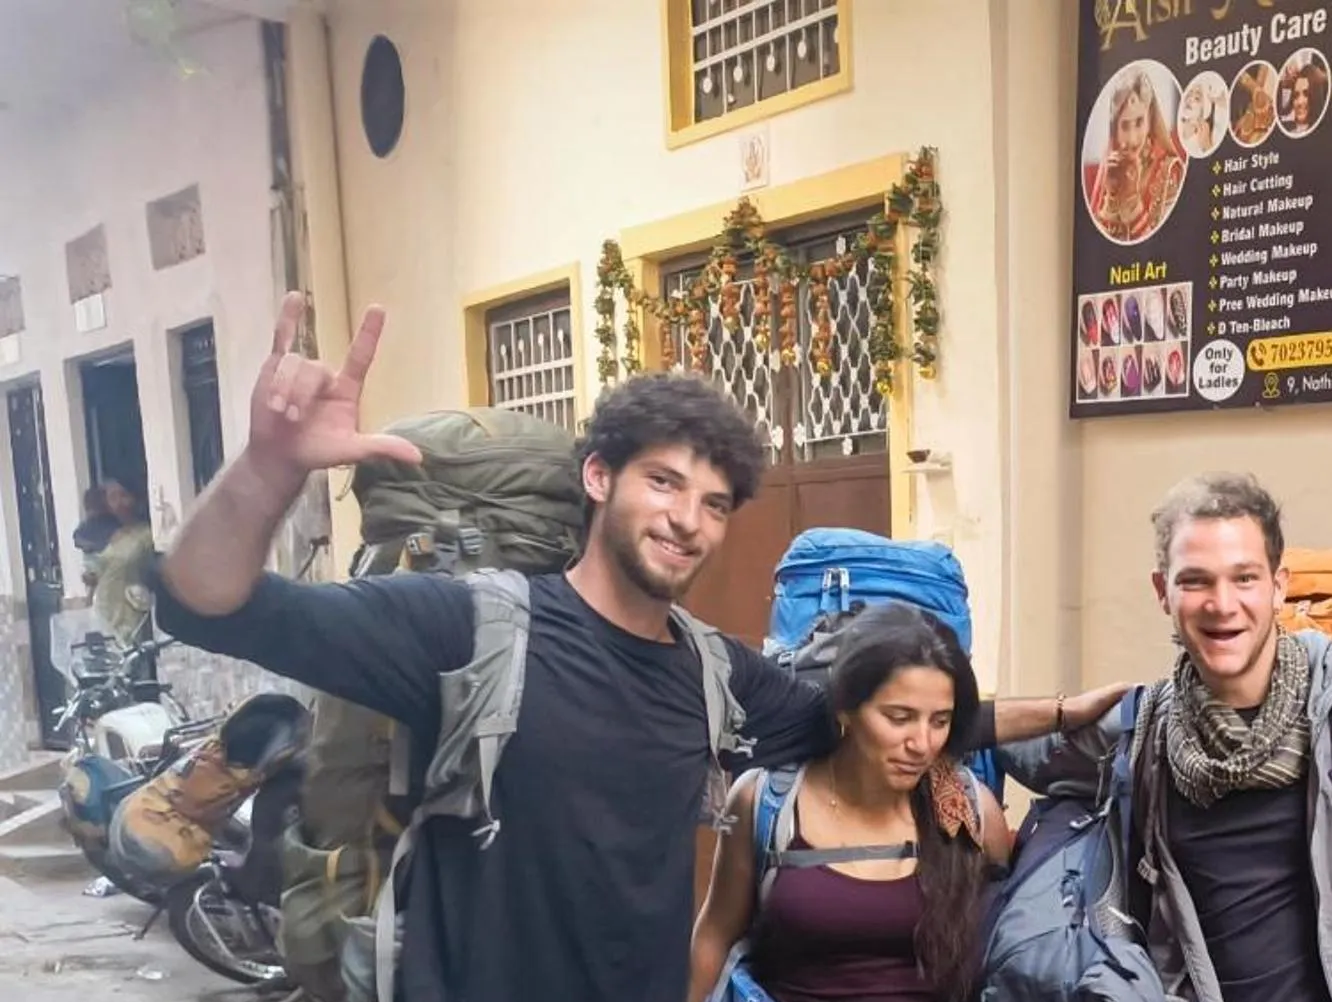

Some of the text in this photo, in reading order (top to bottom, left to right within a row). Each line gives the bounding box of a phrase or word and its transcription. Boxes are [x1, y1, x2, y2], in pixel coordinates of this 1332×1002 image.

[1185, 23, 1262, 66] Beauty
[1271, 8, 1327, 43] Care
[1224, 151, 1280, 173] Hair Style
[1223, 174, 1294, 197] Hair Cutting
[1222, 195, 1314, 219] Natural Makeup
[1221, 221, 1305, 243] Bridal Makeup
[1221, 242, 1318, 265] Wedding Makeup
[1109, 261, 1167, 285] Nail Art
[1219, 269, 1298, 290] Party Makeup
[1219, 298, 1244, 312] Pree
[1246, 292, 1294, 308] Wedding
[1204, 347, 1233, 362] Only
[1209, 362, 1228, 374] for
[1198, 376, 1238, 389] Ladies
